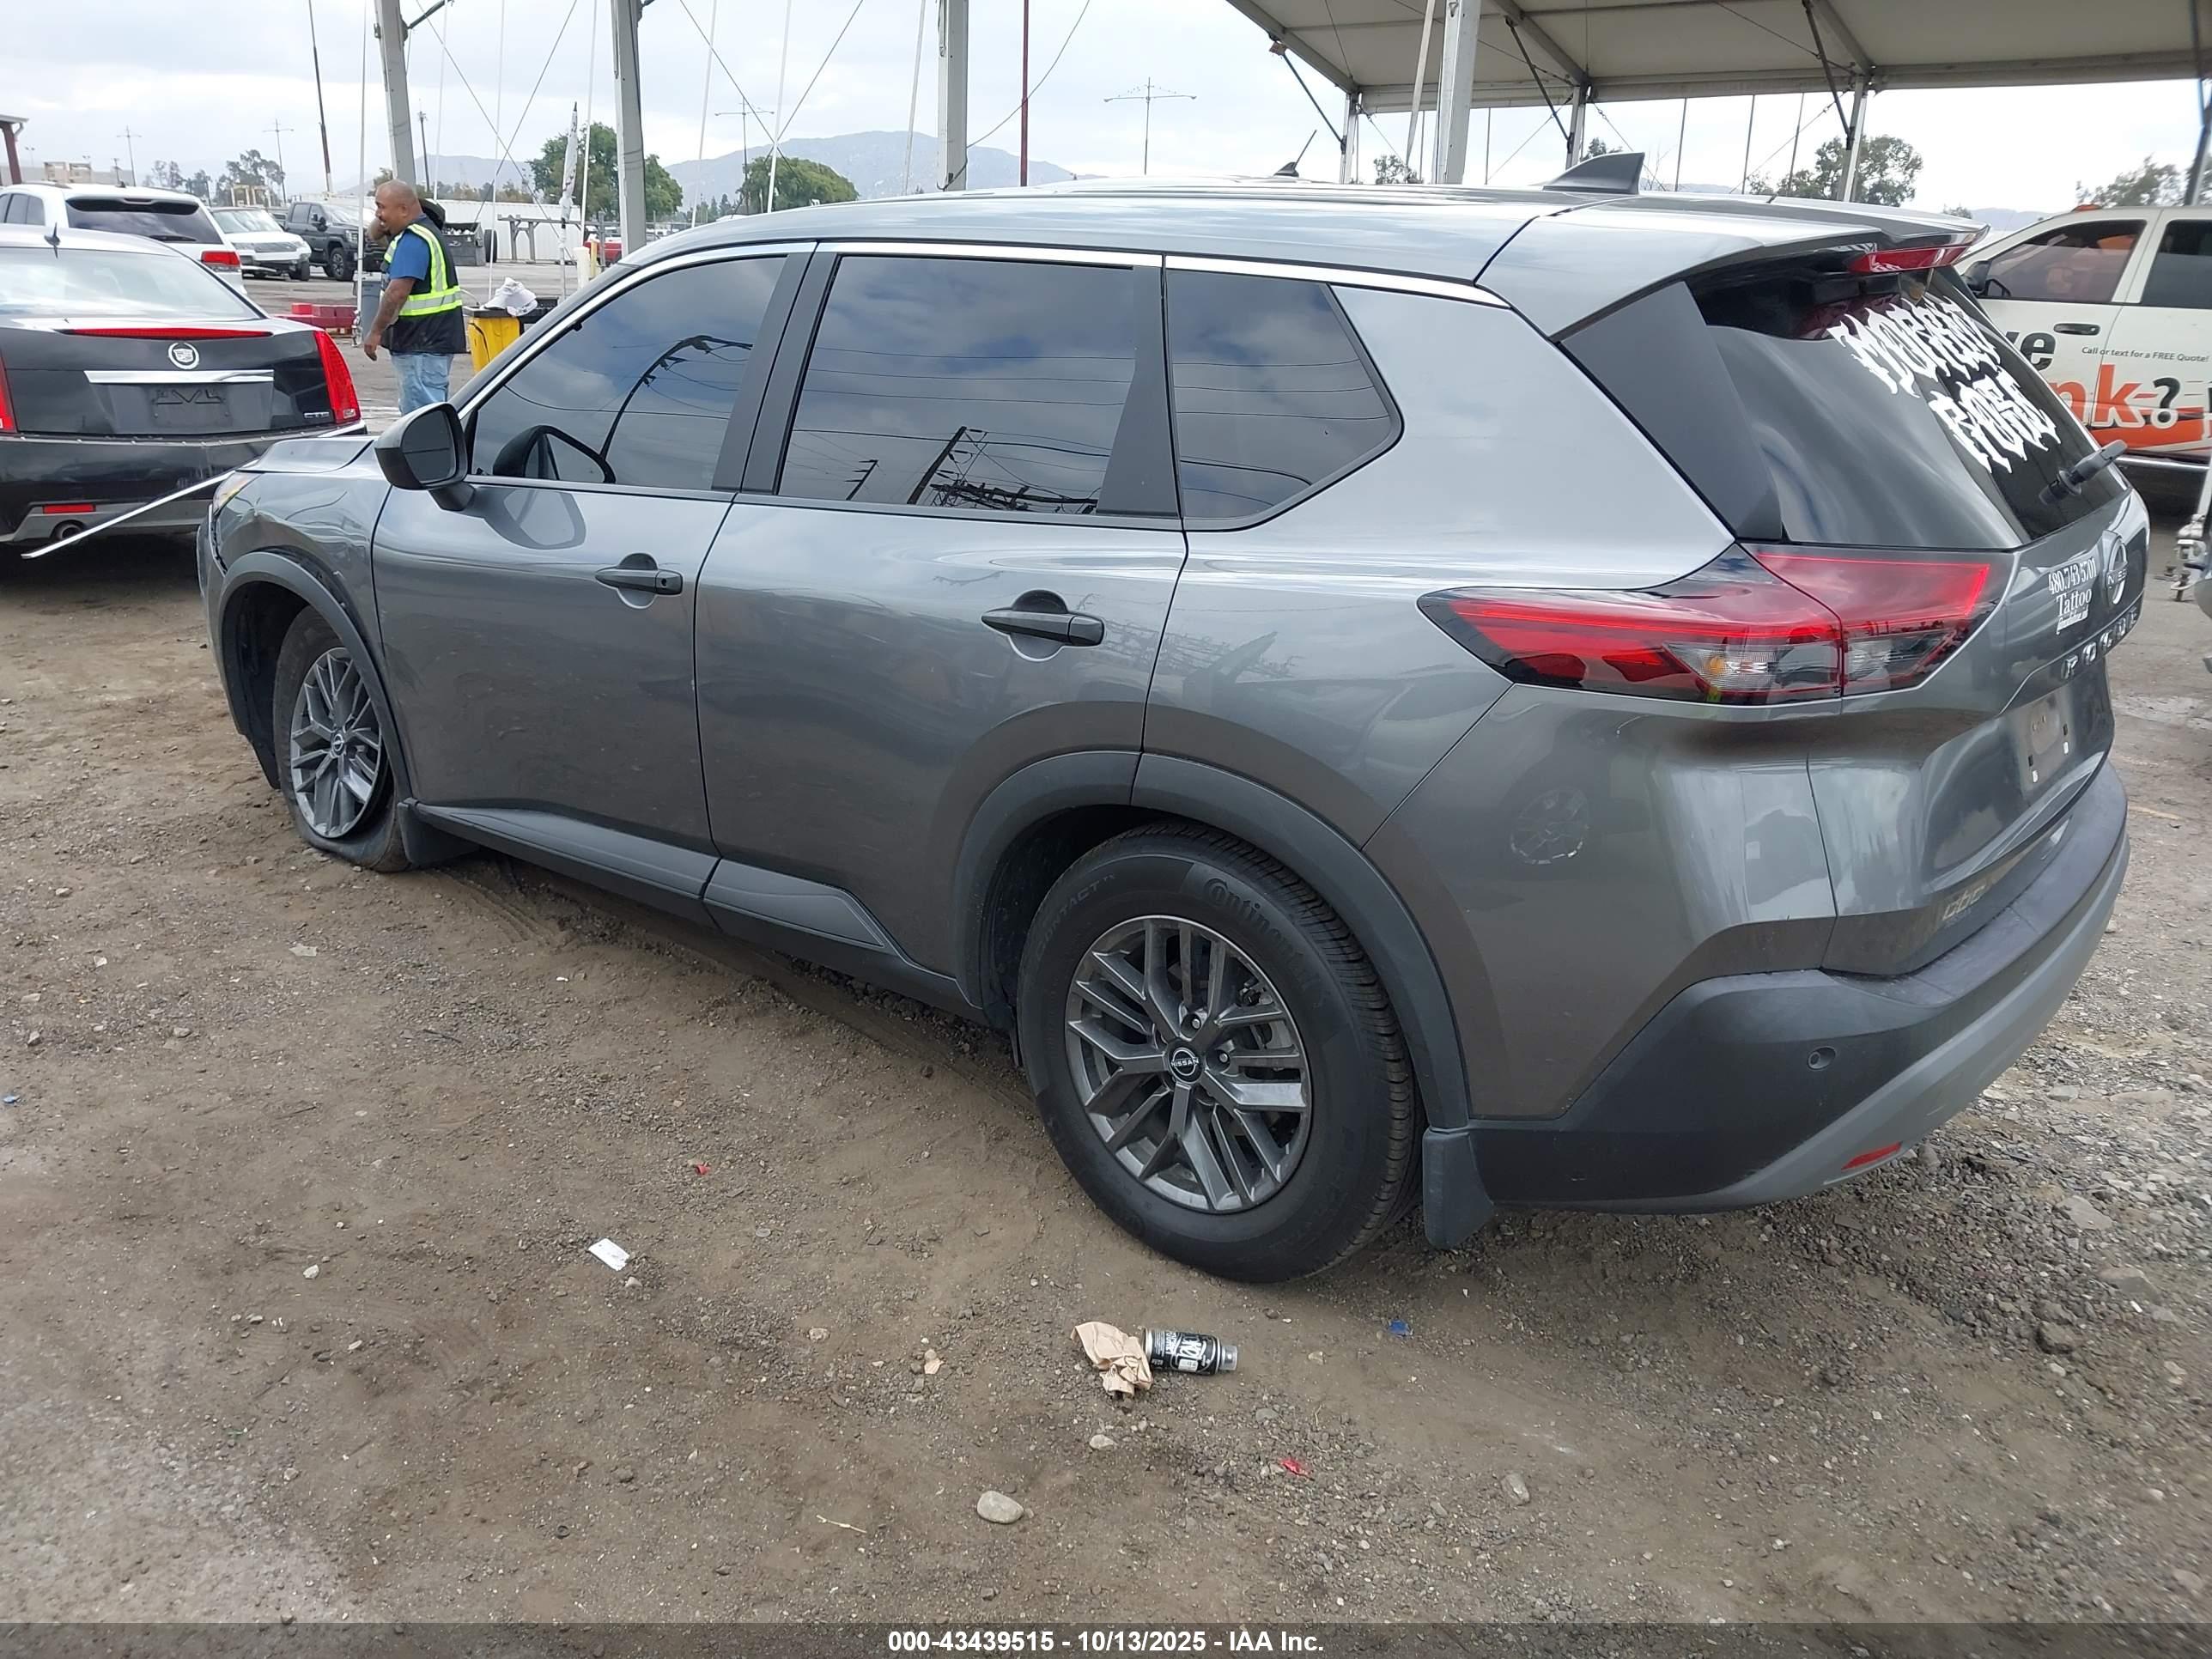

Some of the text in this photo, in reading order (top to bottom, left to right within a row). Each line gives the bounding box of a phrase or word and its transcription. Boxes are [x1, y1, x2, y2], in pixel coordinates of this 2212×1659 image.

[2081, 346, 2099, 355] Call
[2111, 349, 2129, 357] text
[2130, 349, 2143, 359] for
[2152, 351, 2176, 361] FREE
[2177, 353, 2209, 363] Quote!
[2056, 588, 2093, 617] Tattoo
[1170, 1056, 1200, 1067] NISSAN
